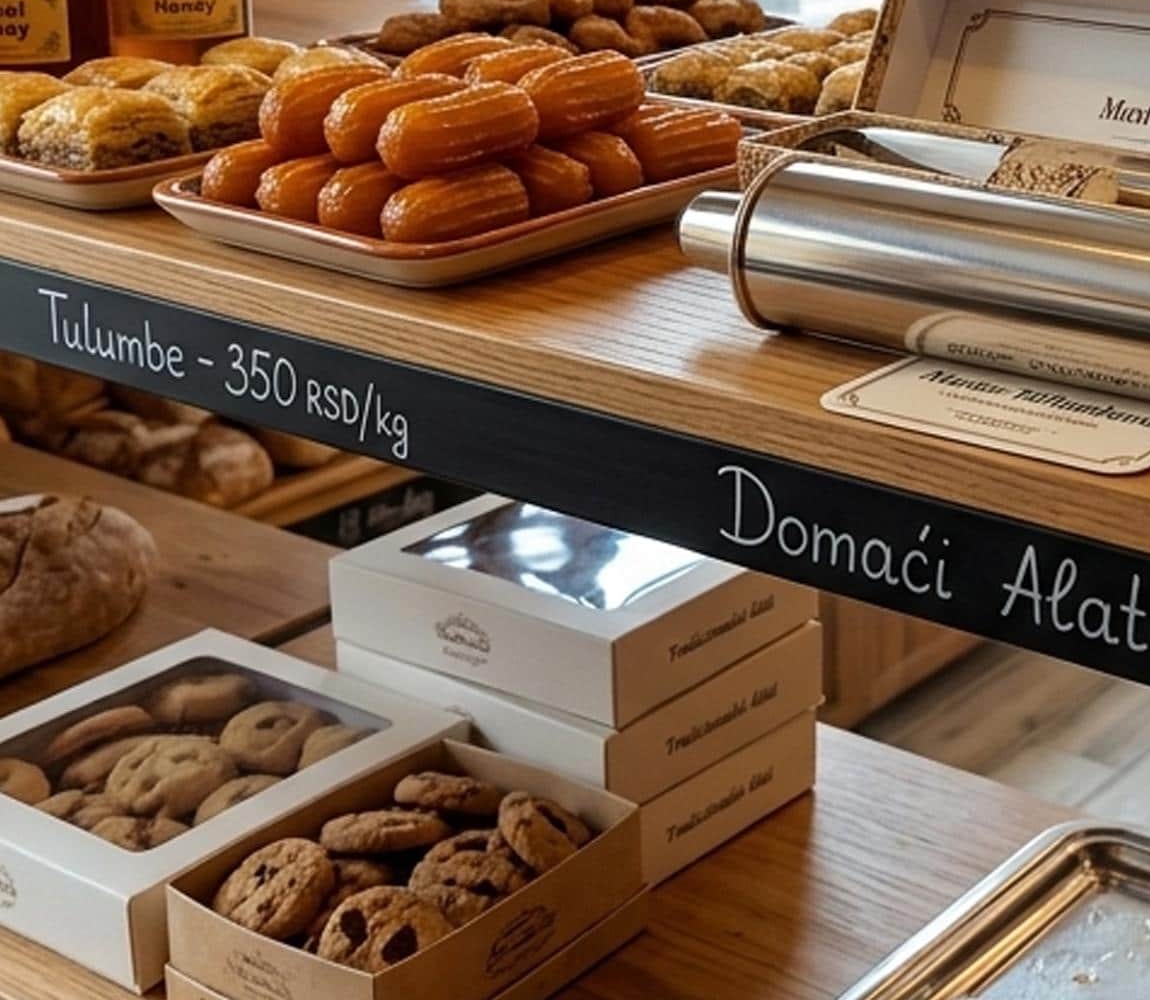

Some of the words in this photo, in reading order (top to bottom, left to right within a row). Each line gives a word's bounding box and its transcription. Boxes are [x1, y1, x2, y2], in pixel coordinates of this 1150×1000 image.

[38, 288, 186, 378] Tulumbe
[224, 343, 298, 407] 350
[305, 379, 410, 459] RSD/kg
[718, 465, 952, 599] Domaći
